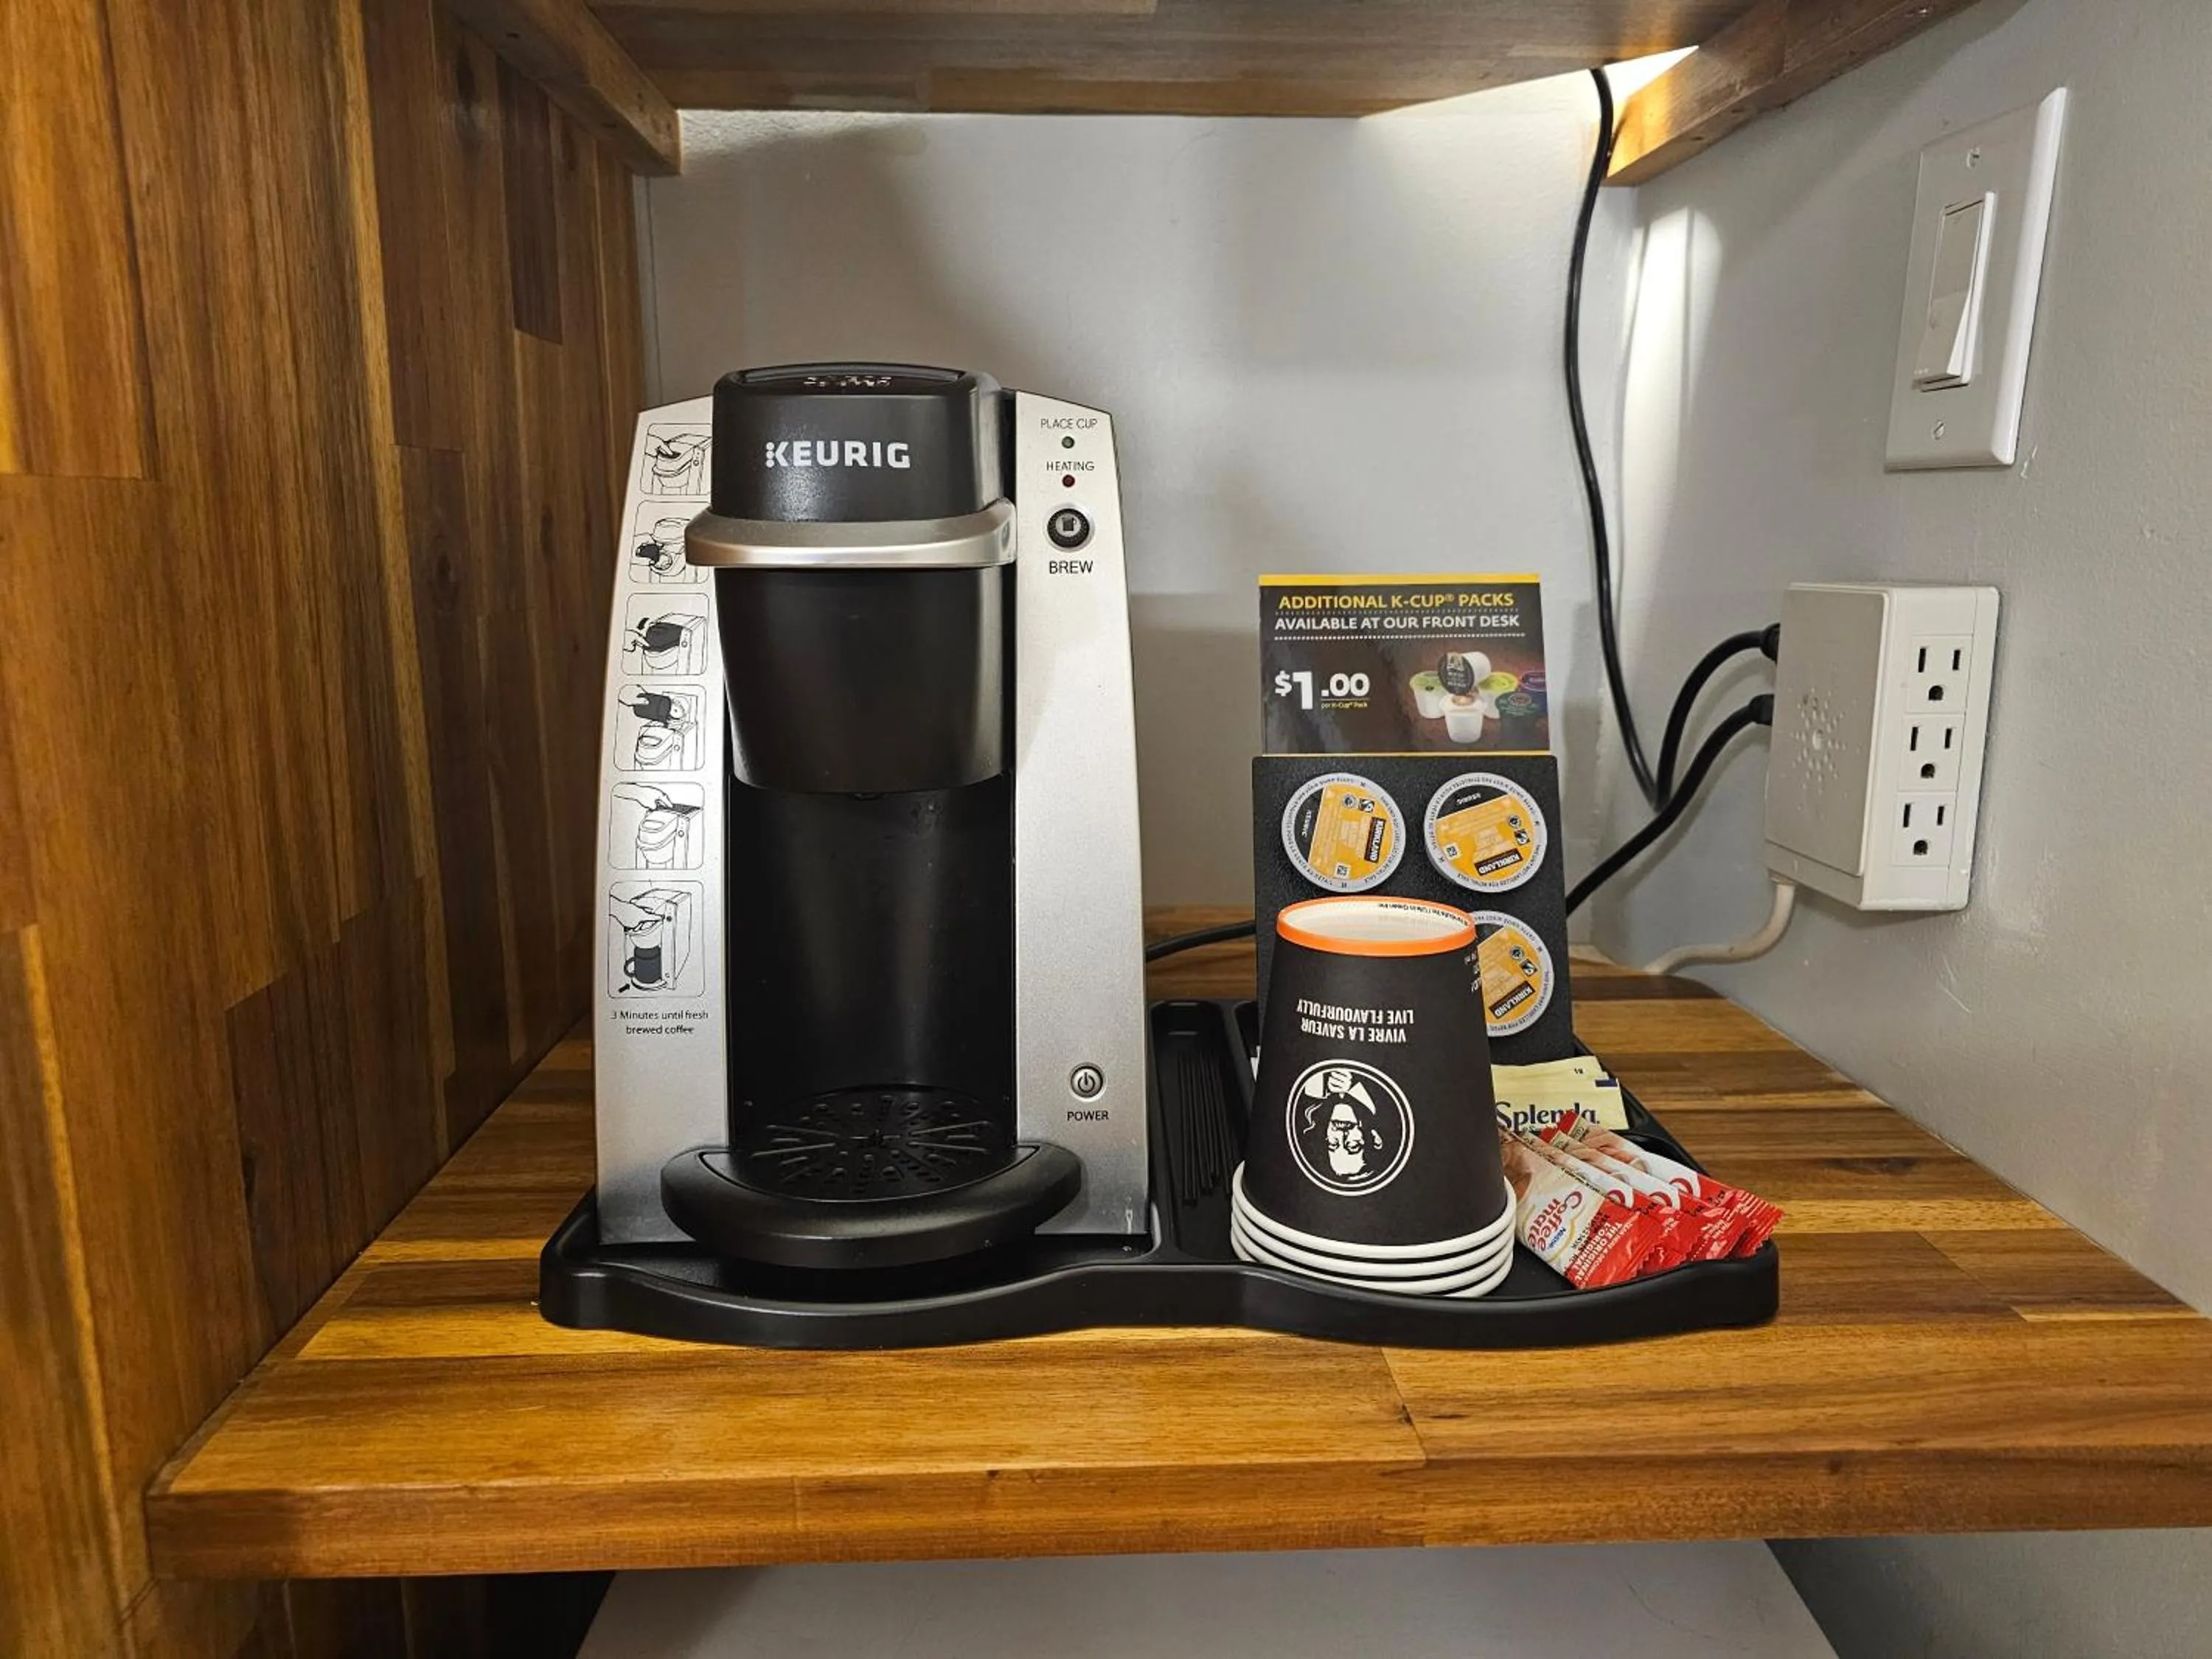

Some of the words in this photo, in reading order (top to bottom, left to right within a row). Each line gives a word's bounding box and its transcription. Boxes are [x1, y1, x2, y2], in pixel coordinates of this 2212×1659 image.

[1040, 418, 1074, 429] PLACE
[1076, 418, 1098, 429] CUP
[765, 440, 911, 468] KEURIG
[1046, 461, 1095, 471] HEATING
[1049, 560, 1093, 574] BREW
[1278, 595, 1387, 610] ADDITIONAL
[1458, 593, 1514, 607] PACKS
[1274, 617, 1357, 630] AVAILABLE
[1360, 617, 1380, 629] AT
[1382, 616, 1419, 629] OUR
[1422, 616, 1476, 628] FRONT
[1480, 614, 1520, 627] DESK
[1369, 820, 1384, 862] KIRKLAND
[1478, 853, 1520, 874] KIRKLAND
[1495, 986, 1533, 1018] KIRKLAND
[611, 1011, 617, 1020] 3
[619, 1010, 658, 1020] Minutes
[661, 1010, 684, 1020] until
[685, 1010, 709, 1020] fresh
[1296, 998, 1383, 1025] FLAVOURFULLY
[1387, 1009, 1414, 1025] LIVE
[626, 1025, 663, 1034] brewed
[665, 1025, 695, 1034] coffee
[1301, 1017, 1345, 1039] SAVEUR
[1348, 1026, 1364, 1041] LA
[1368, 1027, 1407, 1043] VIVRE
[1067, 1110, 1109, 1121] POWER
[1528, 1197, 1561, 1248] mate
[1538, 1191, 1582, 1251] Coffee
[1605, 1221, 1623, 1239] THE
[1574, 1237, 1608, 1281] ORIGINAL
